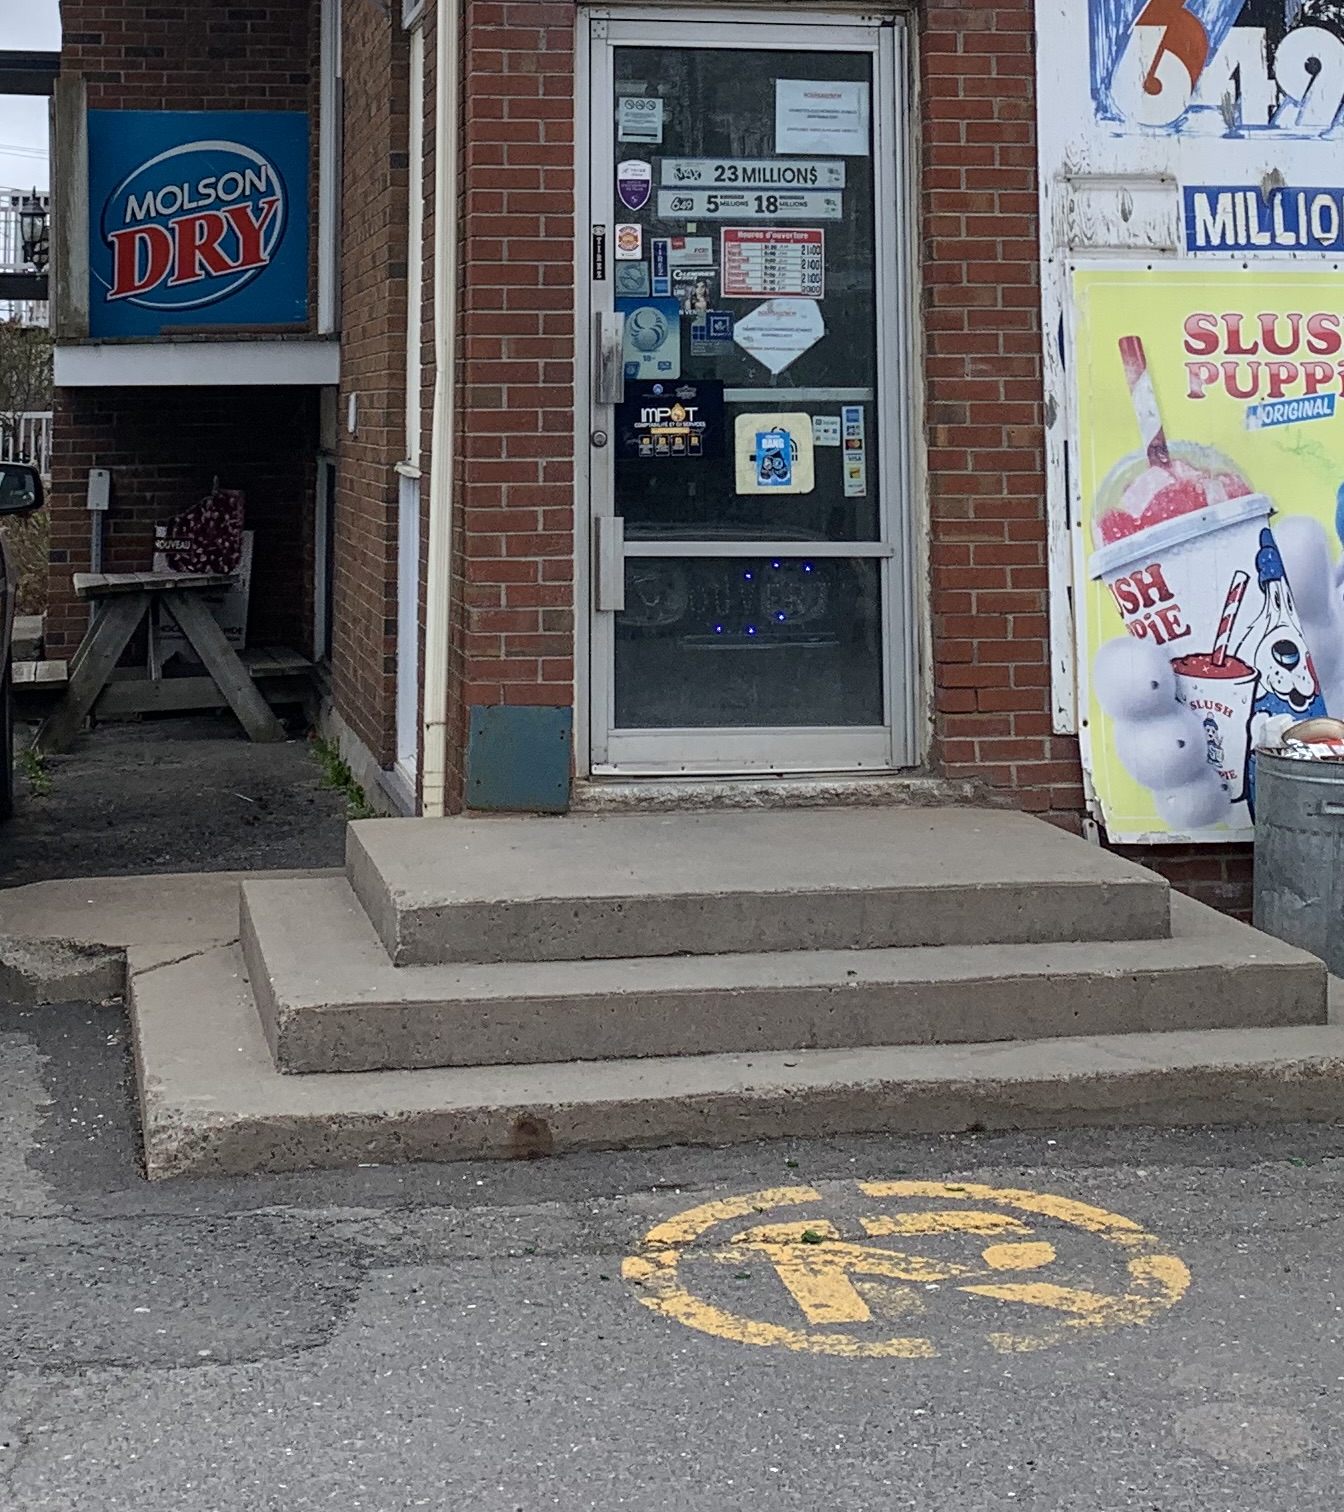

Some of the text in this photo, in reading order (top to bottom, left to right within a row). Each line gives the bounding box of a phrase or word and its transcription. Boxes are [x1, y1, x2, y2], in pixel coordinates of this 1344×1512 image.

[713, 164, 739, 183] 23
[123, 164, 269, 224] MOLSON
[706, 194, 720, 214] 5
[754, 194, 779, 214] 18
[106, 198, 281, 302] DRY
[1262, 397, 1333, 424] ORIGINAL
[1190, 699, 1234, 719] SLUSH
